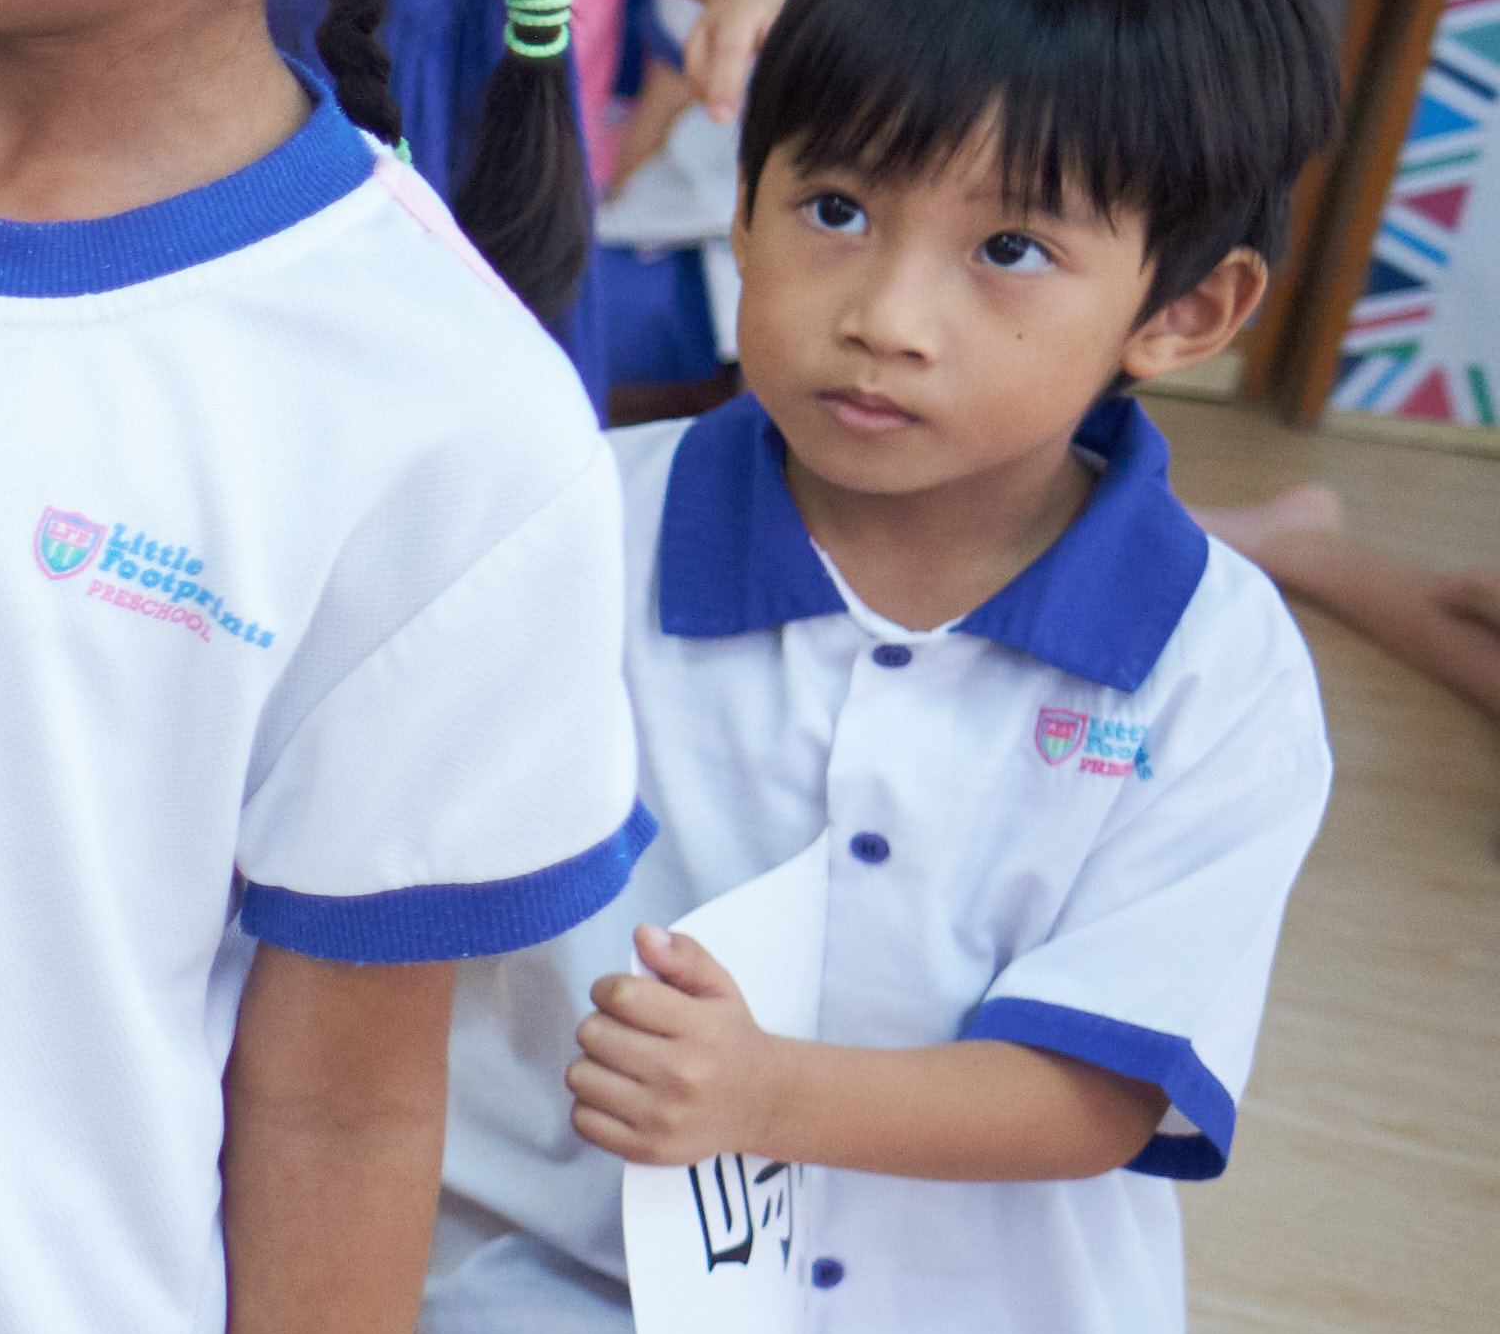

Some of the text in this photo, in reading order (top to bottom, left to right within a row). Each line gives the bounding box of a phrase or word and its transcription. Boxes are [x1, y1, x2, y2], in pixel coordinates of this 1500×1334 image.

[107, 522, 205, 576] Little
[87, 579, 211, 643] PRESCHOOL
[99, 547, 276, 649] Footprints
